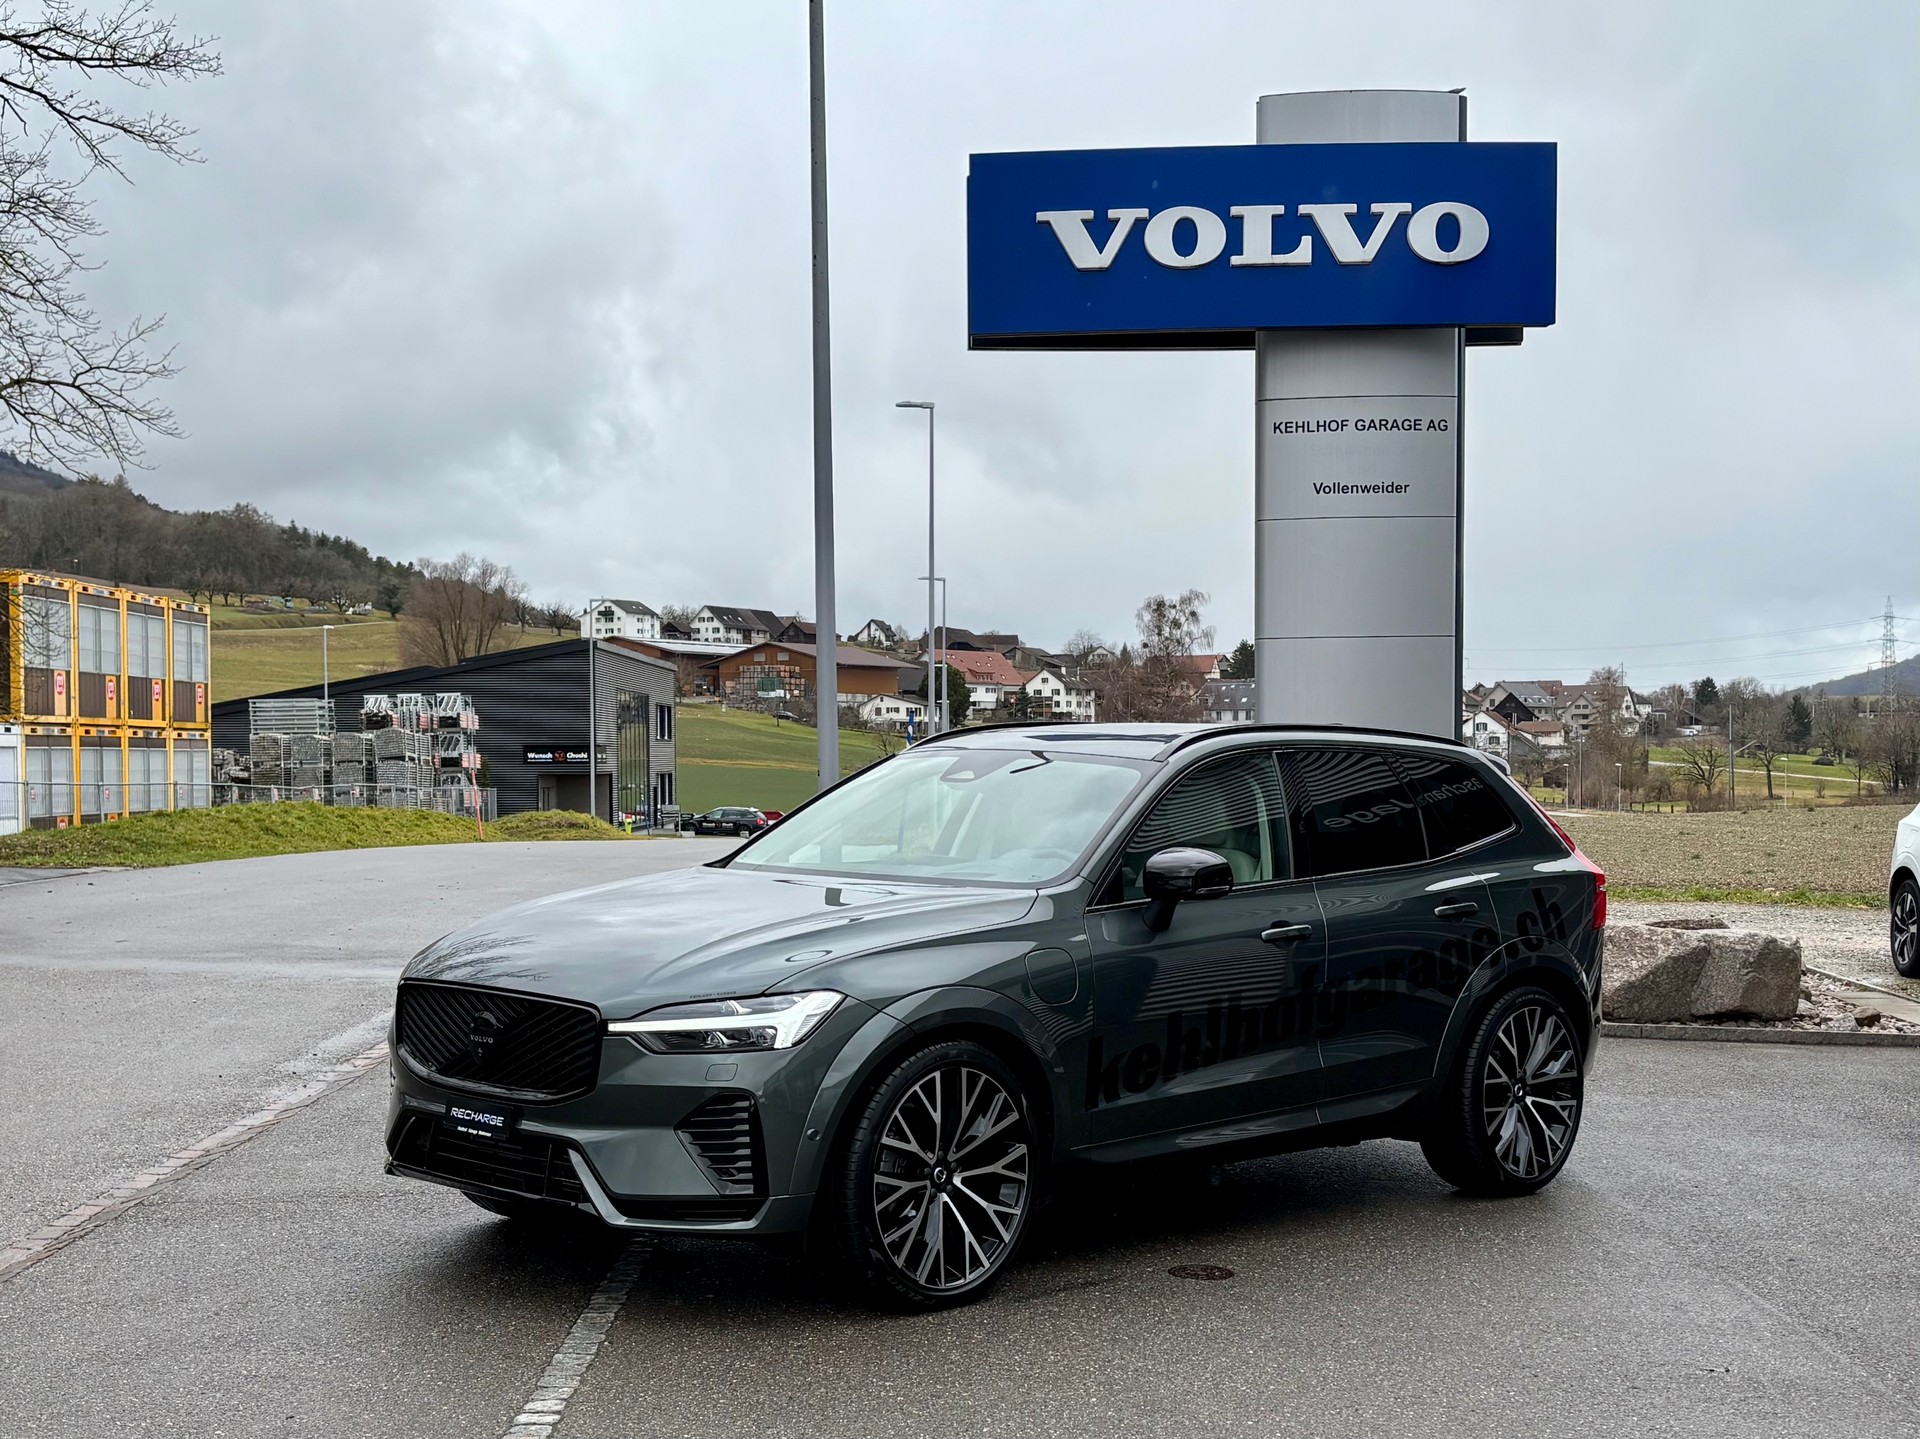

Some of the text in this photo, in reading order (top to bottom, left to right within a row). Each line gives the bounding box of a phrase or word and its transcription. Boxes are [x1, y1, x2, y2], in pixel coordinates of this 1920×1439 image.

[1036, 202, 1490, 271] VOLVO
[1273, 418, 1449, 434] KEHLHOF GARAGE AG
[1313, 481, 1410, 494] Vollenweider
[1085, 887, 1568, 1110] kehlhofgarage.ch
[470, 1034, 494, 1044] VOLVO
[450, 1107, 505, 1126] RECHARGE
